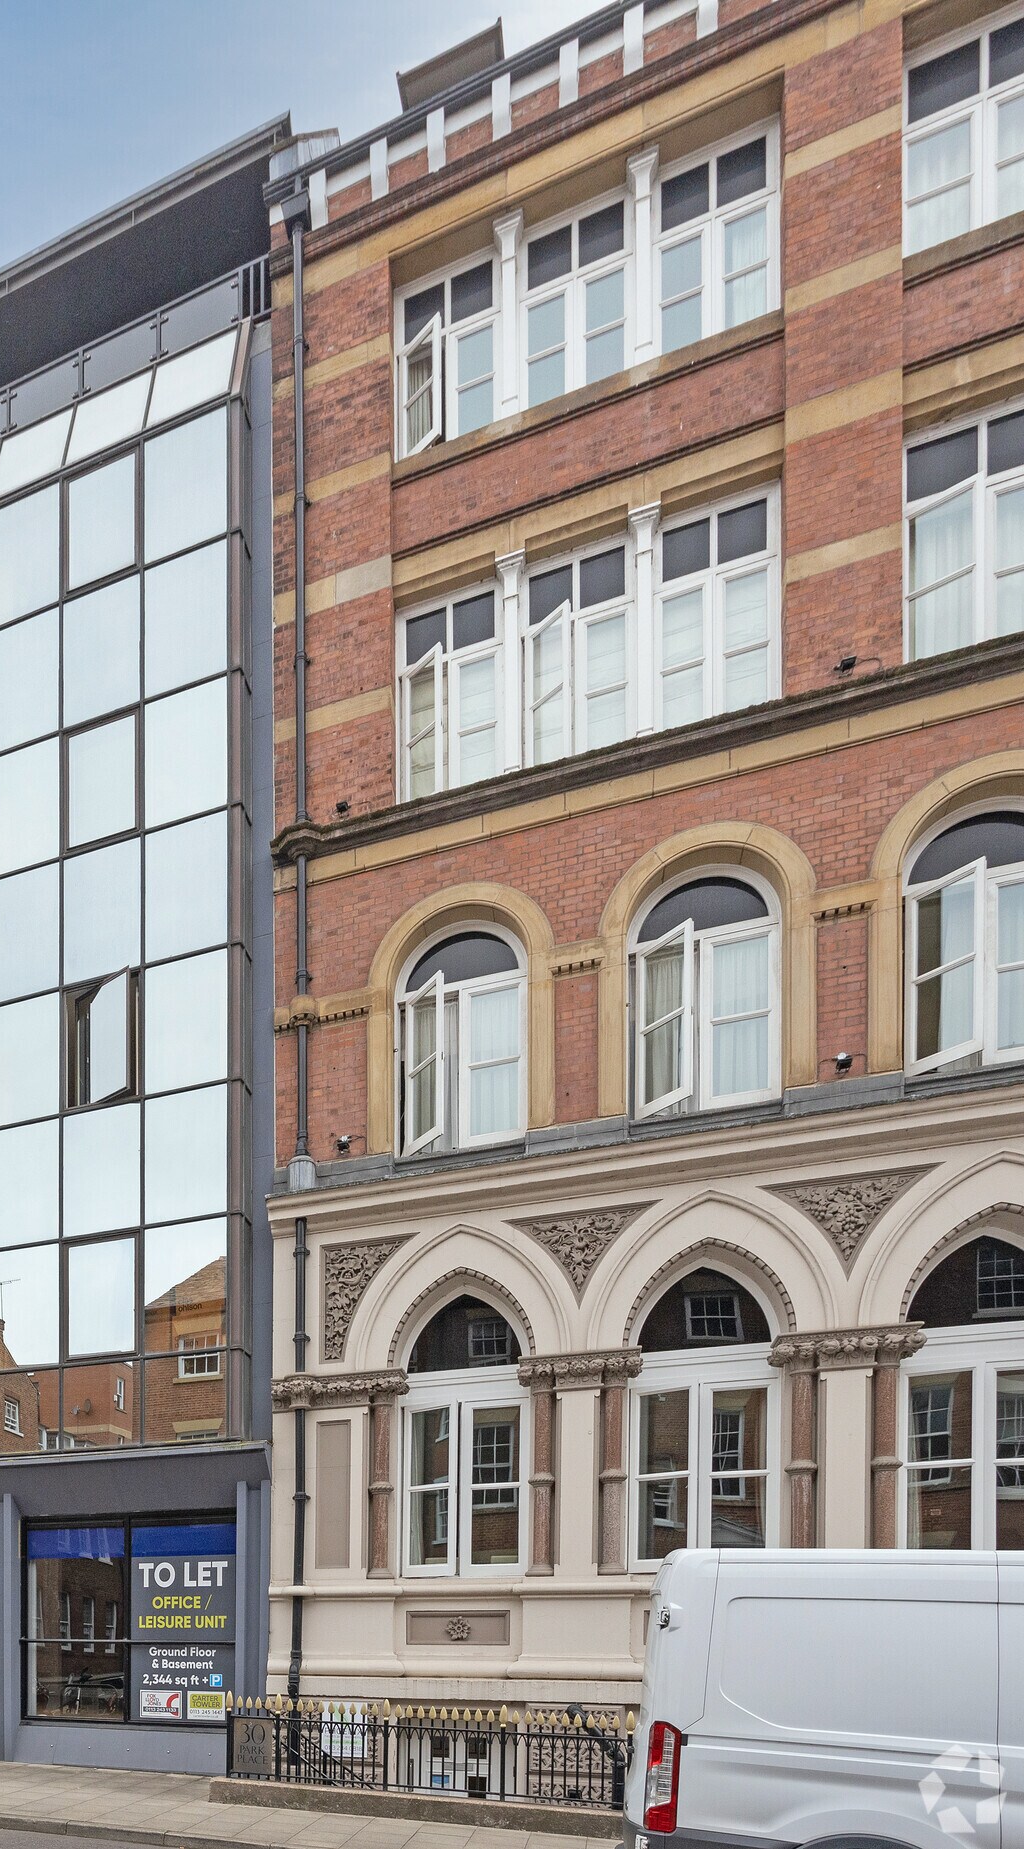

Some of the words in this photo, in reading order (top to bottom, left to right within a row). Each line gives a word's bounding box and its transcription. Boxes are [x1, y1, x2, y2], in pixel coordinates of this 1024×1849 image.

[138, 1561, 176, 1588] TO
[183, 1560, 228, 1587] LET
[152, 1595, 201, 1609] OFFICE
[138, 1615, 192, 1629] LEISURE
[195, 1615, 227, 1629] UNIT
[148, 1646, 188, 1657] Ground
[189, 1646, 217, 1657] Floor
[151, 1658, 160, 1669] &
[161, 1659, 214, 1669] Basement
[142, 1673, 173, 1686] 2,344
[174, 1676, 188, 1688] sq
[190, 1674, 200, 1686] ft
[191, 1694, 219, 1702] CARTER
[240, 1723, 266, 1745] 30
[239, 1745, 265, 1755] PARK
[237, 1754, 269, 1765] PLACE
